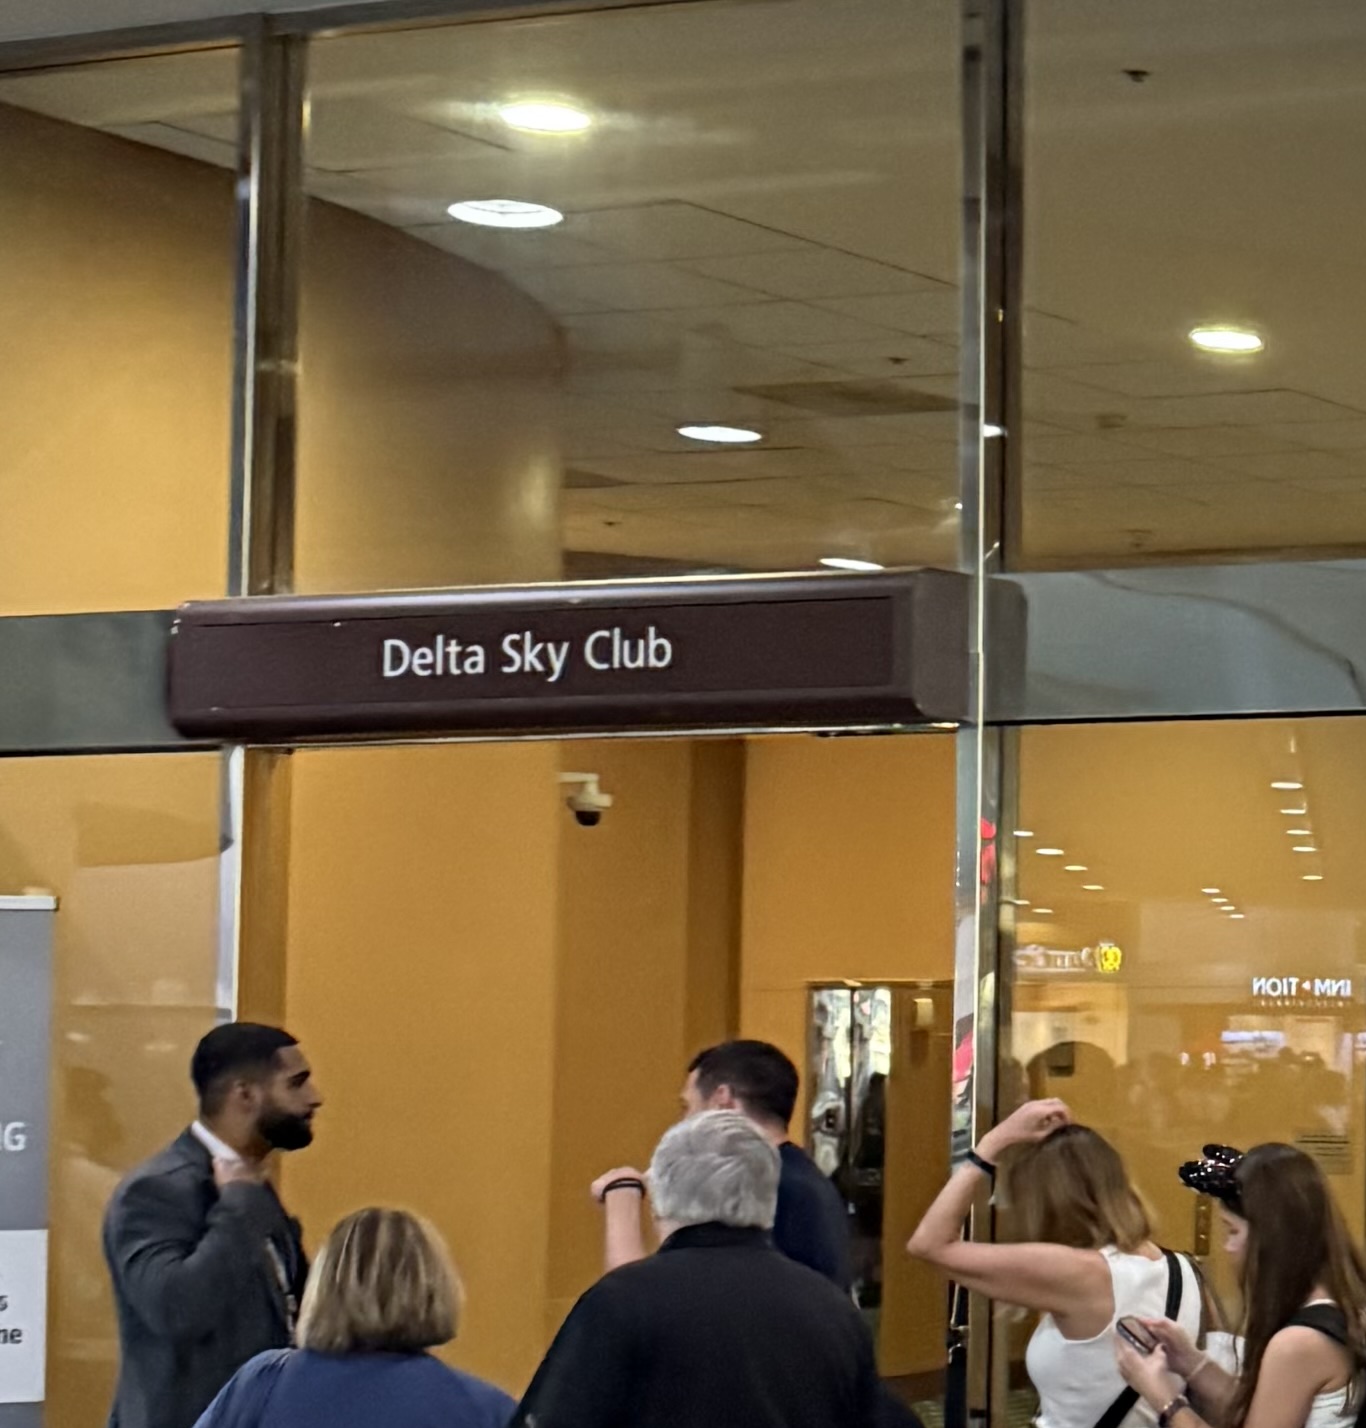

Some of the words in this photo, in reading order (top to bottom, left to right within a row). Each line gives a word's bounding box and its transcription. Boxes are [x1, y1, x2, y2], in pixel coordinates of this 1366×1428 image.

[382, 634, 485, 677] Delta
[501, 630, 570, 682] Sky
[584, 626, 673, 670] Club
